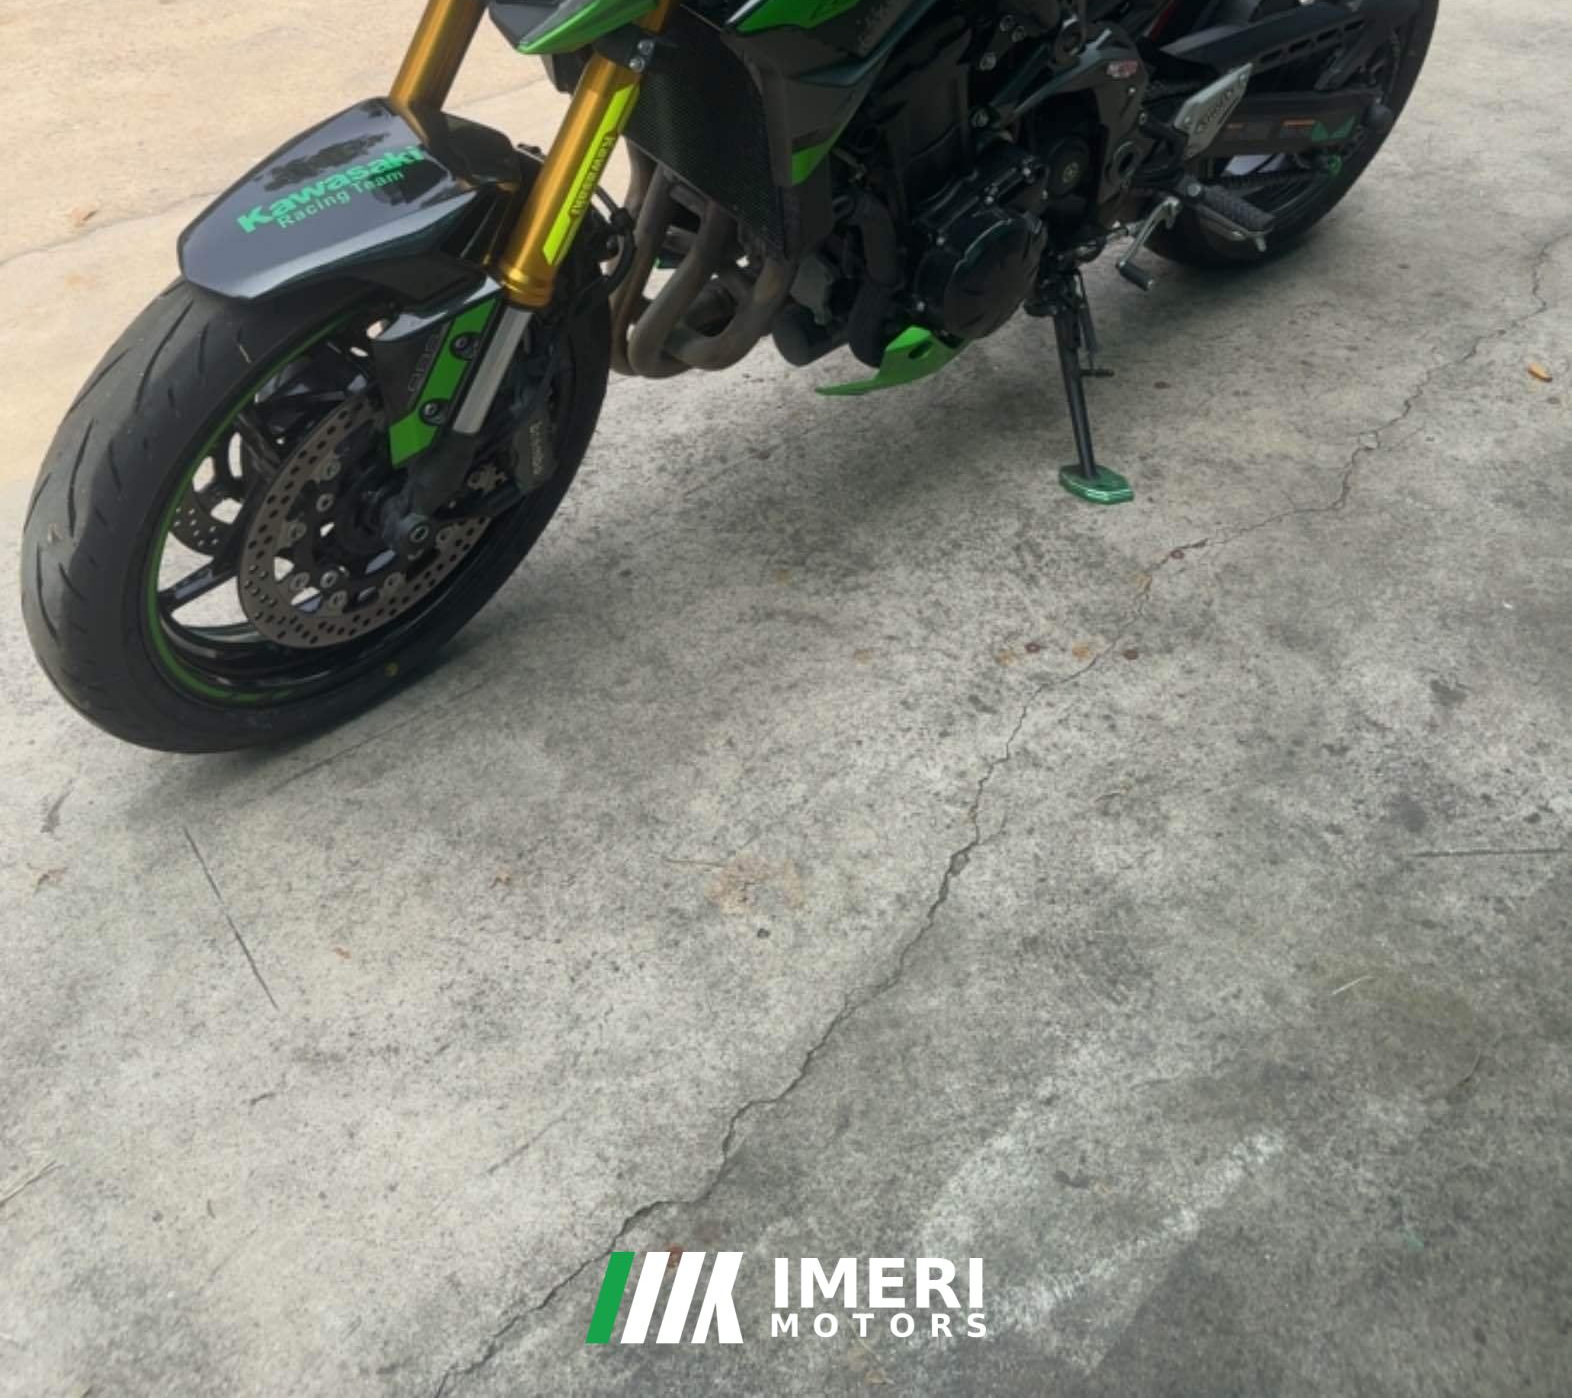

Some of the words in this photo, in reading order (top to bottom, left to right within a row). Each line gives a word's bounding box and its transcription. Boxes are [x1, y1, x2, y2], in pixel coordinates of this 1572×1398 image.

[237, 145, 425, 232] Kawasaki
[276, 190, 350, 229] Racing
[351, 168, 404, 194] Team
